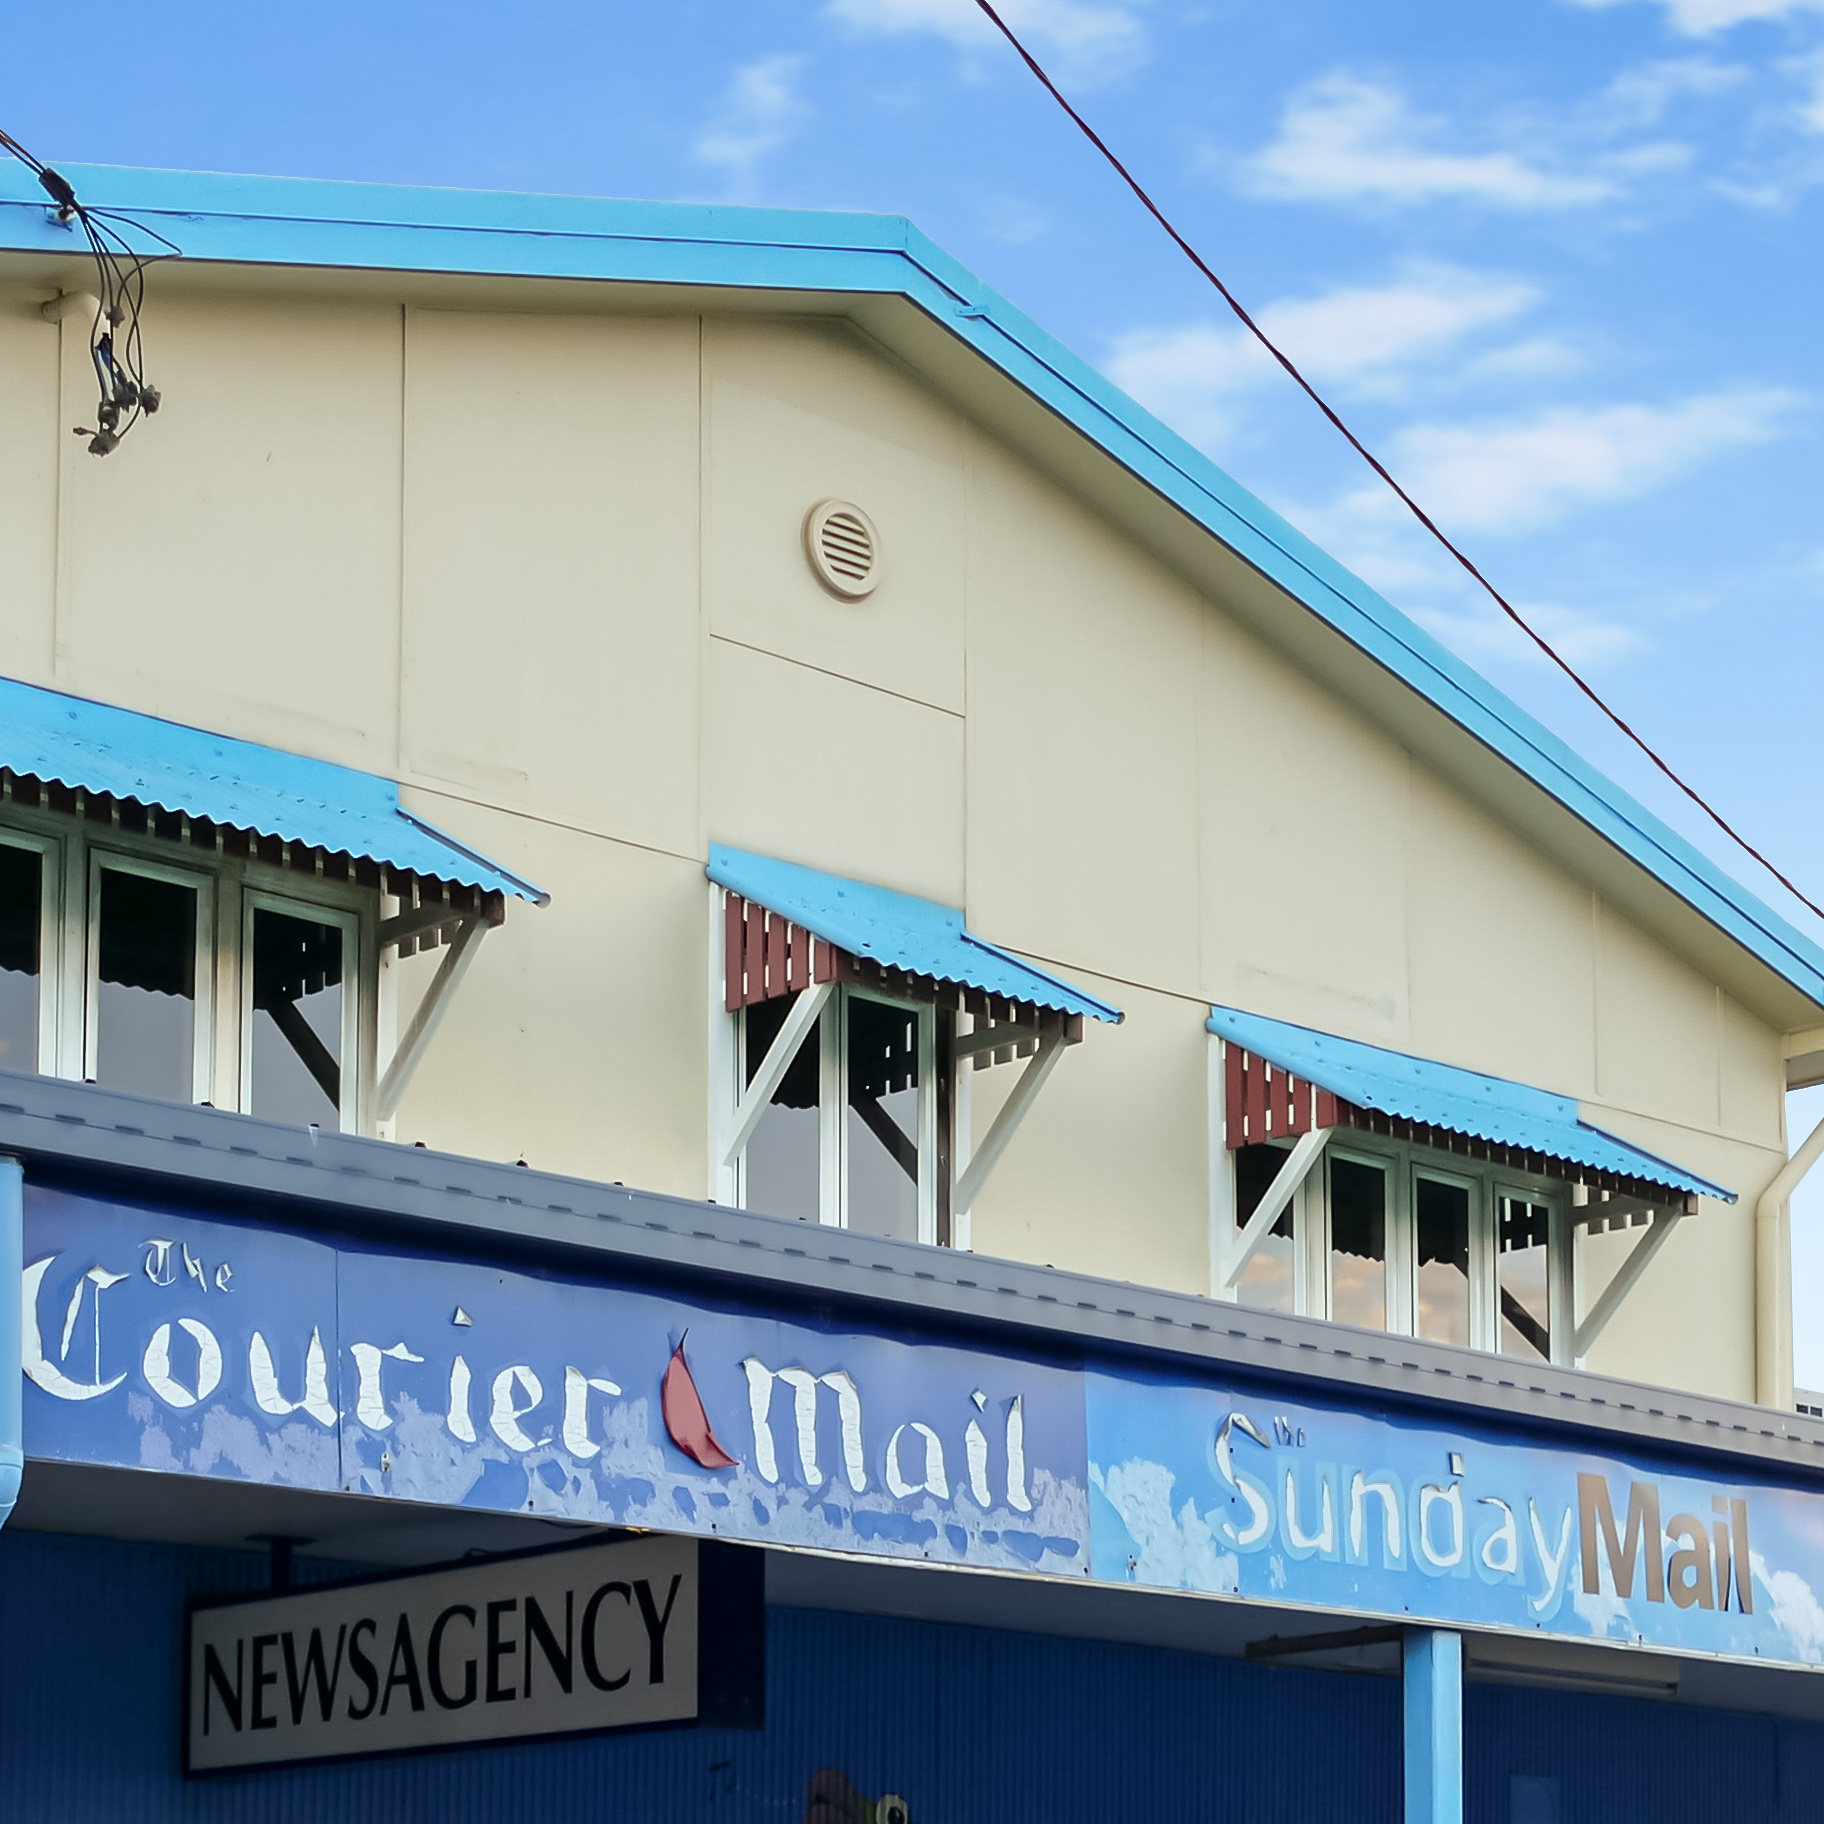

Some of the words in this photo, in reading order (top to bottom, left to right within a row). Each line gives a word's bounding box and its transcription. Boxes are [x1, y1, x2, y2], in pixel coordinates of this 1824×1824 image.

[139, 1238, 235, 1295] The
[22, 1254, 622, 1458] Courier
[743, 1356, 1033, 1512] Mail
[1206, 1412, 1574, 1620] Sunday
[1578, 1473, 1755, 1617] Mail
[202, 1574, 684, 1737] NEWSAGENCY
